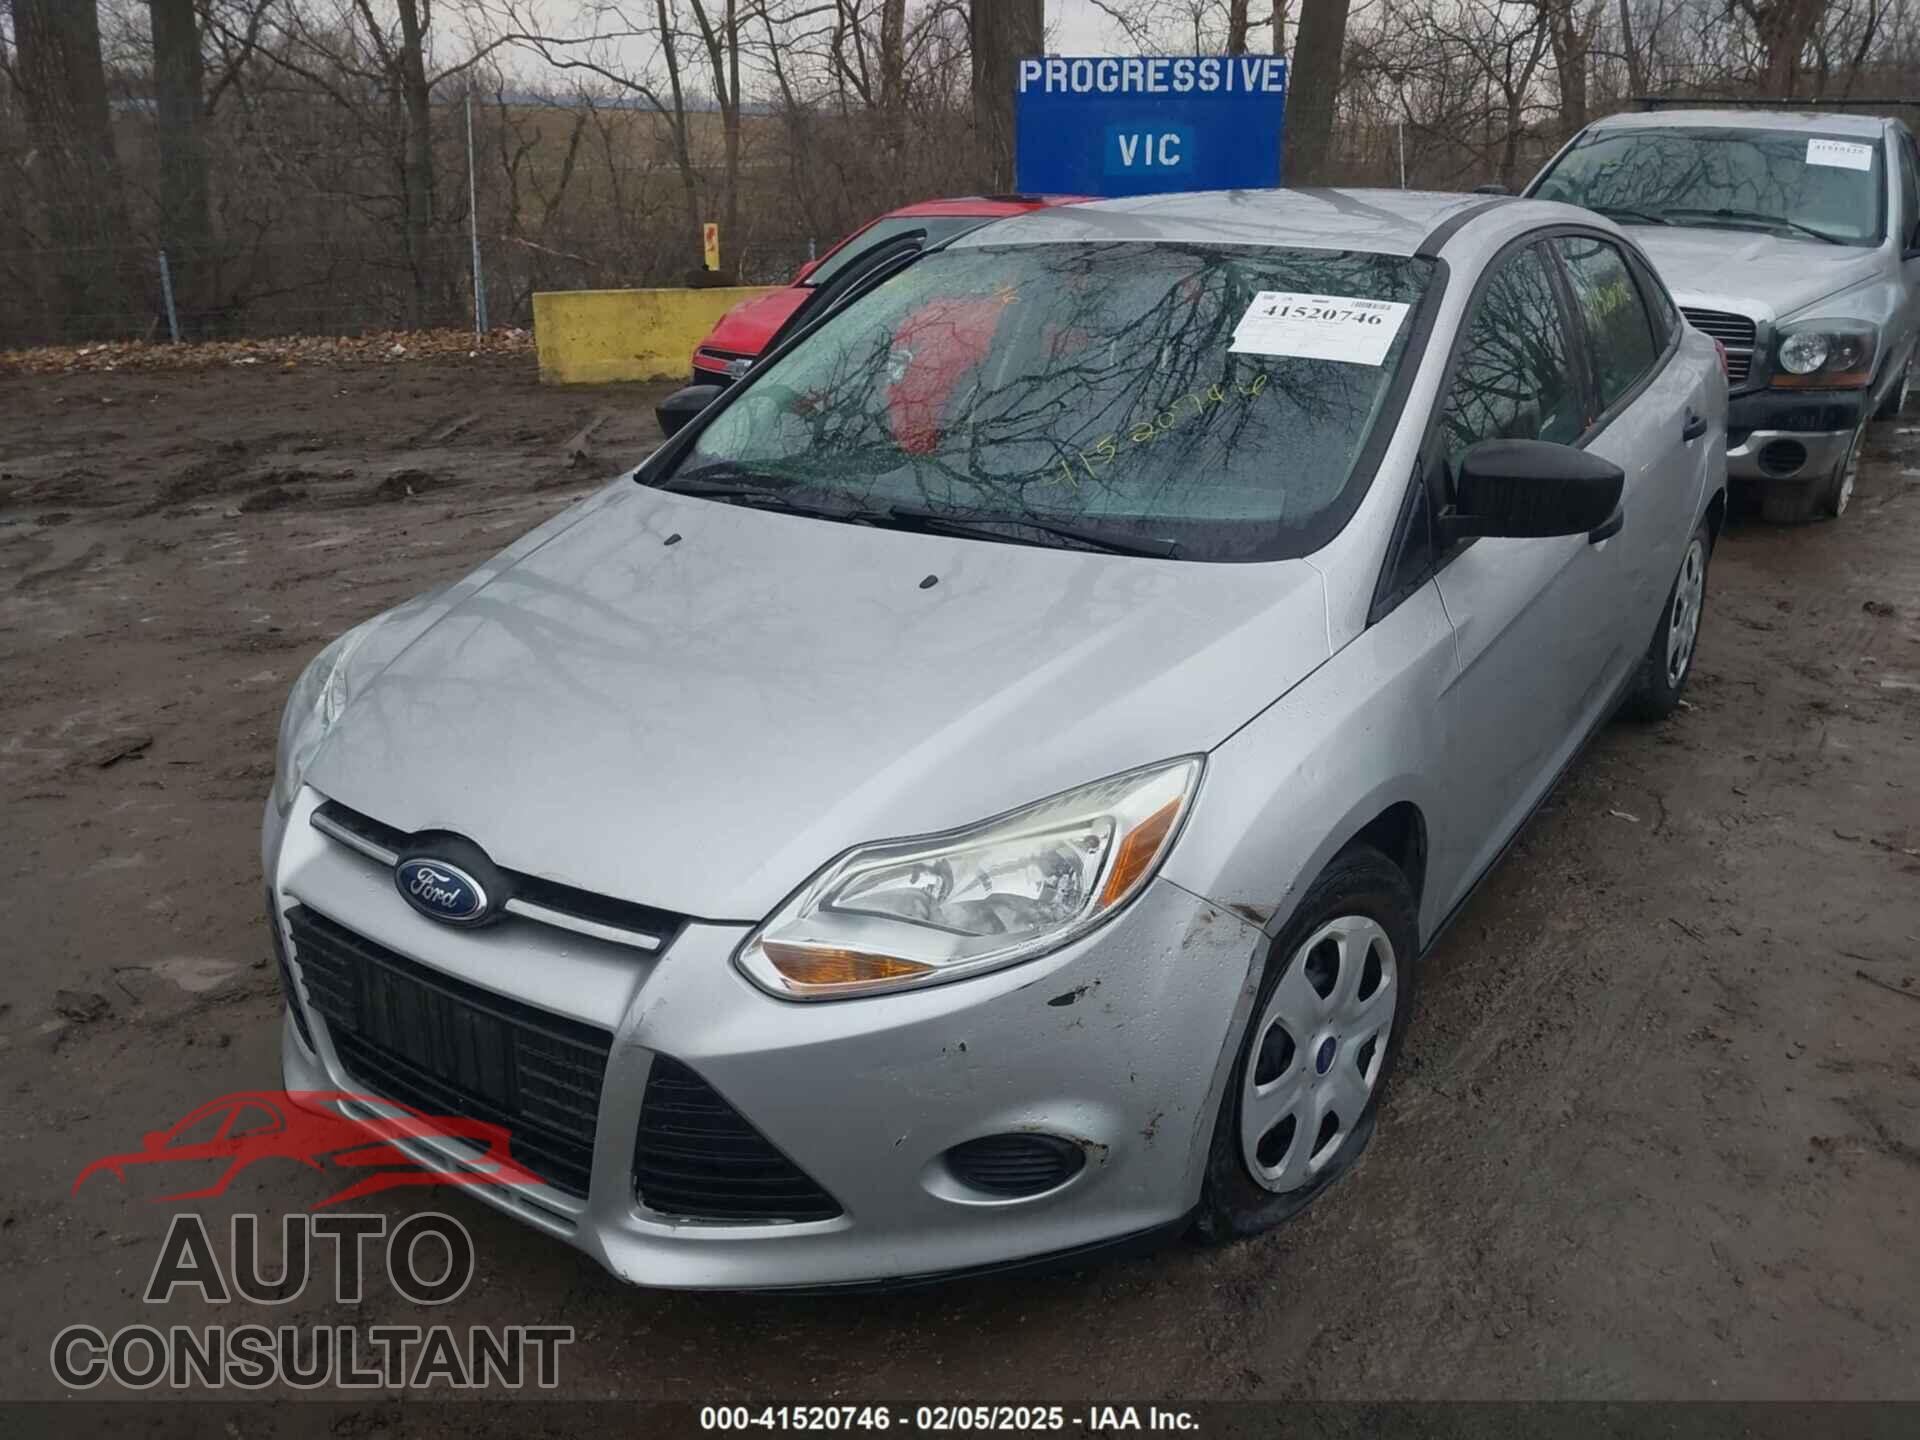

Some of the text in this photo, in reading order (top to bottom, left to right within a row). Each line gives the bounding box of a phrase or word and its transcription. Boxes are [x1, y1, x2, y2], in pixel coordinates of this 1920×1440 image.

[1019, 59, 1285, 93] PROGRESSIVE
[1118, 133, 1181, 167] VIC
[1262, 304, 1383, 326] 41520746
[410, 867, 461, 908] Ford
